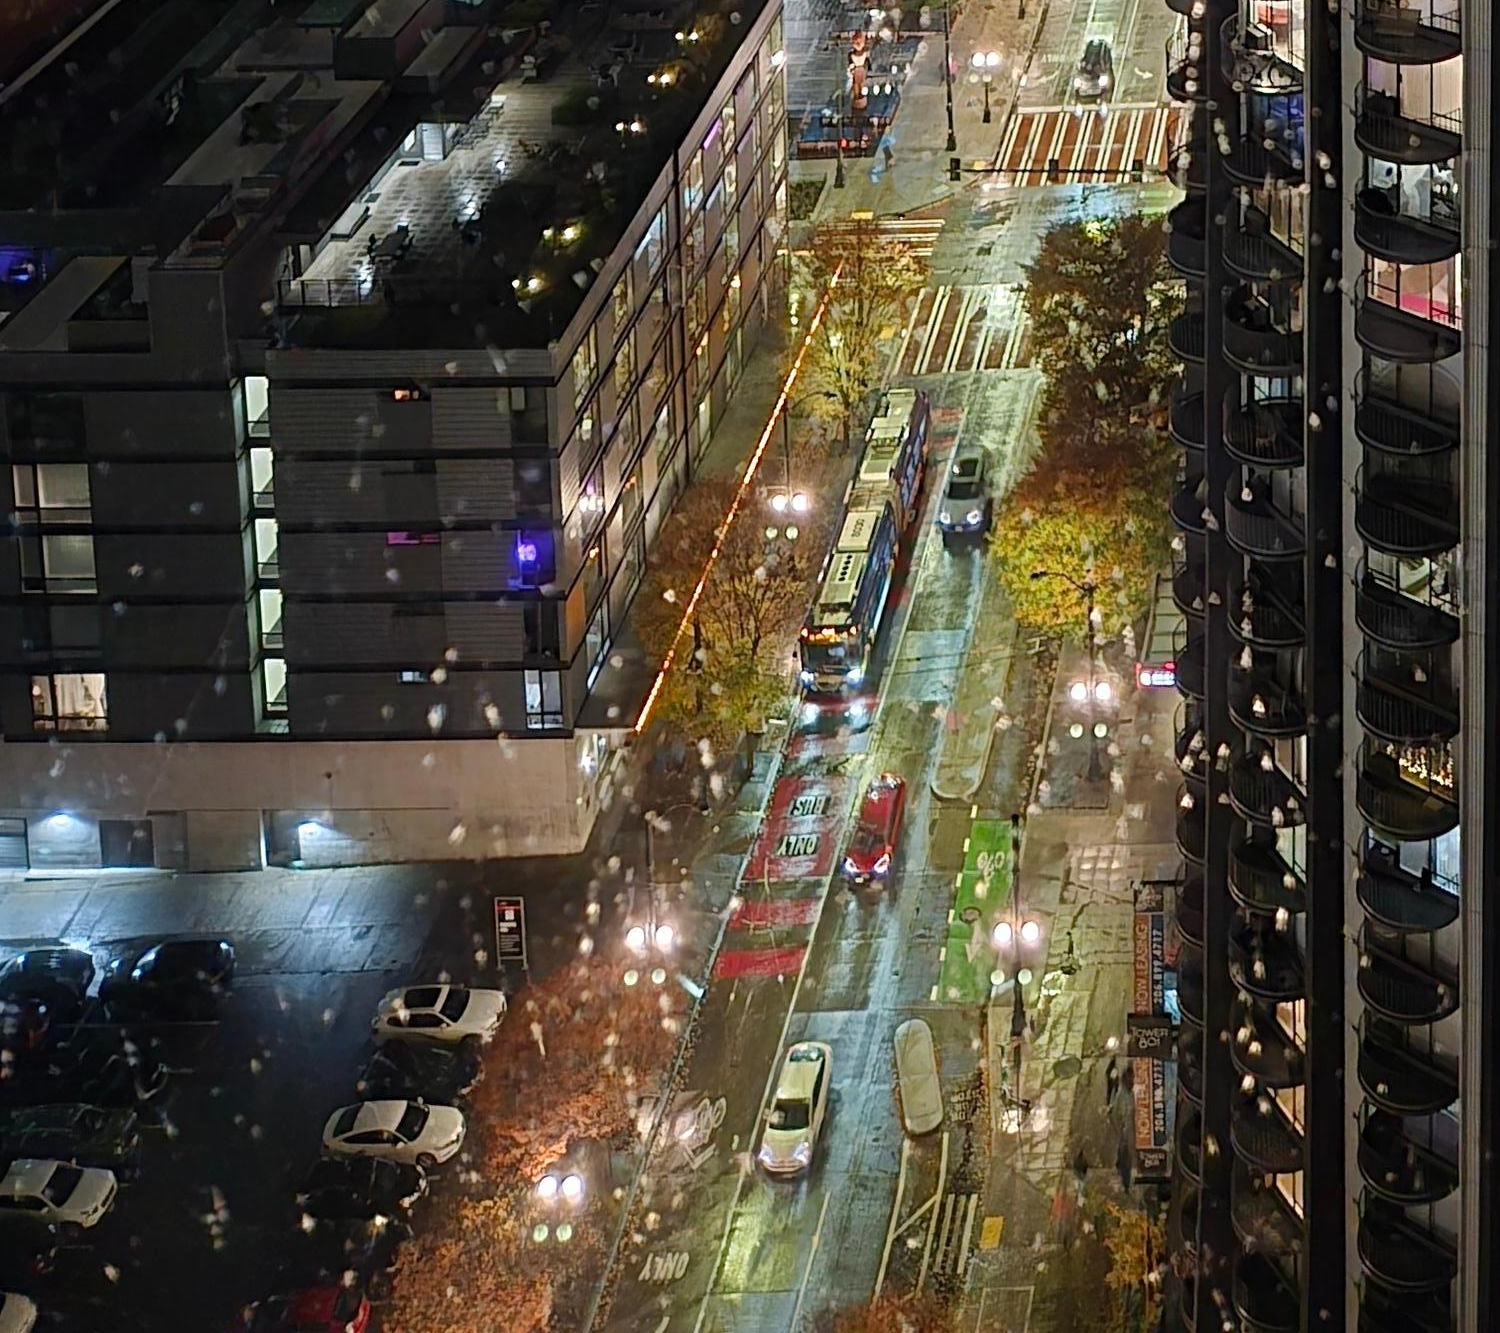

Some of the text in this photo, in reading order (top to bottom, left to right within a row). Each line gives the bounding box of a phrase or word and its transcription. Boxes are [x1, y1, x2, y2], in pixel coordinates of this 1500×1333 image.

[794, 796, 826, 816] BUS
[776, 834, 817, 856] ONLY
[1136, 924, 1148, 1012] NOW LEASING
[1130, 1026, 1168, 1038] TOWER
[1139, 1037, 1160, 1049] 801
[1137, 1108, 1150, 1138] NOW
[638, 1252, 690, 1281] ONLY
